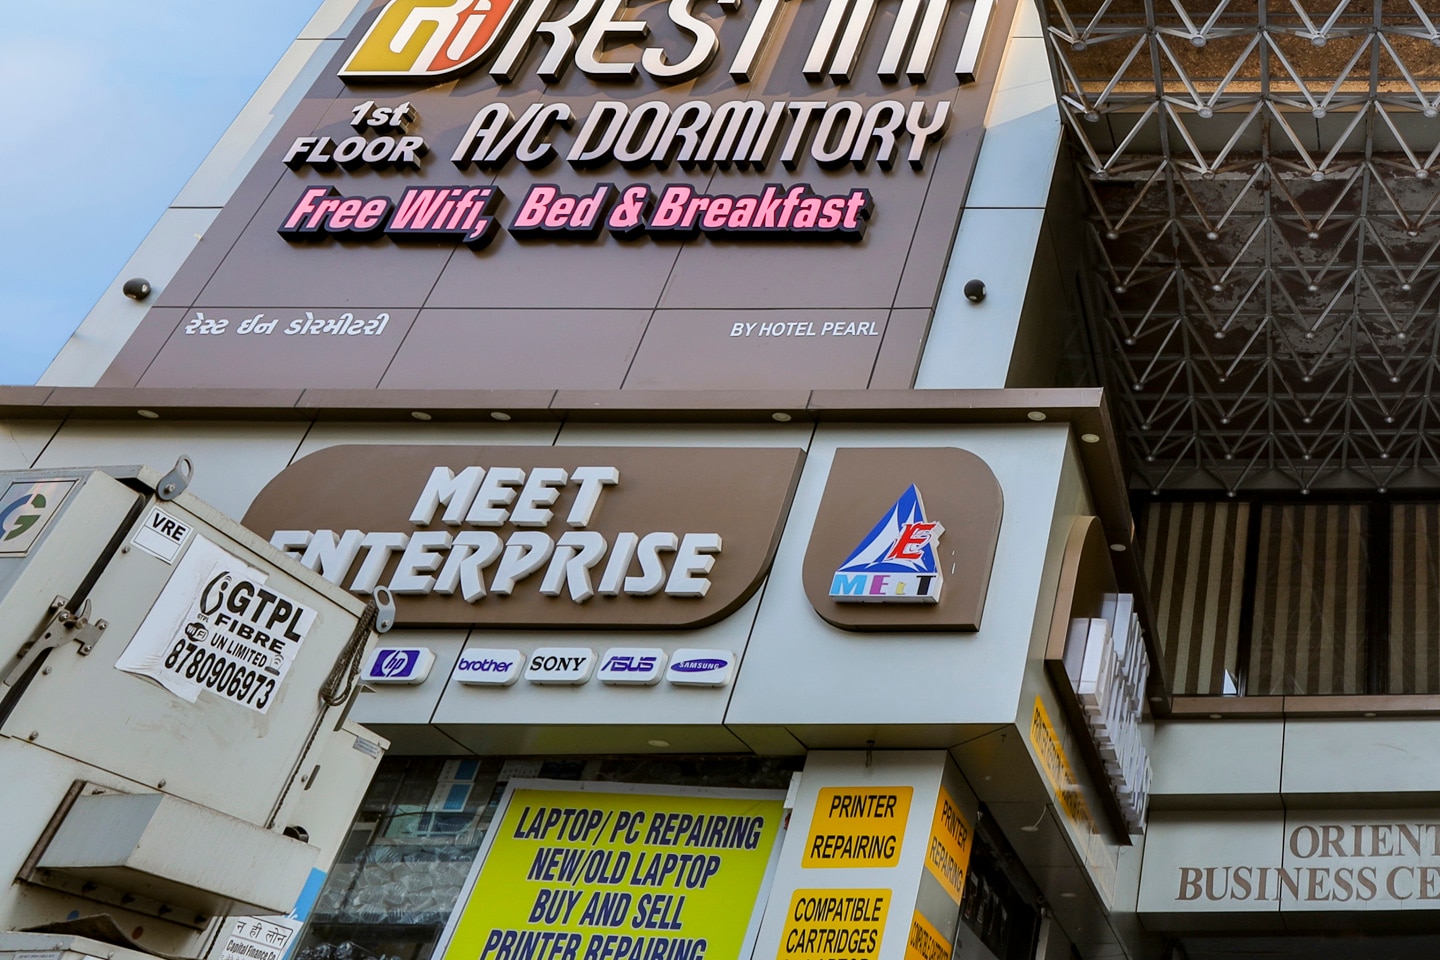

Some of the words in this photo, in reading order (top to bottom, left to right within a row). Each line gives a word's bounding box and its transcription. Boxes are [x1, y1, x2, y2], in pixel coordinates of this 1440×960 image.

[349, 101, 412, 130] 1st
[450, 102, 571, 168] A/C
[567, 101, 952, 171] DORMITORY
[283, 136, 425, 168] FLOOR
[284, 187, 388, 231] Free
[396, 187, 496, 239] Wifi,
[514, 185, 608, 229] Bed
[608, 185, 645, 229] &
[651, 185, 866, 230] Breakfast
[730, 322, 757, 337] BY
[758, 322, 816, 336] HOTEL
[821, 321, 879, 336] PEARL
[409, 466, 619, 528] MEET
[152, 512, 187, 542] VRE
[226, 581, 304, 643] GTPL
[214, 613, 286, 655] FIBRE
[164, 638, 276, 710] 8780906973
[458, 657, 513, 673] brother
[529, 656, 587, 672] SONY
[601, 656, 657, 672] ASUS
[679, 662, 721, 671] SAMSUNG
[828, 795, 898, 819] PRINTER
[513, 806, 613, 846] LAPTOP/
[609, 811, 645, 845] PC
[644, 813, 764, 850] REPAIRING
[940, 799, 969, 853] PRINTER
[810, 835, 897, 860] REPAIRING
[527, 847, 631, 887] NEW/OLD
[630, 852, 721, 889] LAPTOP
[929, 835, 964, 893] REPAIRING
[1174, 865, 1378, 903] BUSINESS
[528, 889, 583, 925] BUY
[579, 891, 633, 928] AND
[632, 893, 686, 930] SELL
[794, 897, 884, 923] COMPATIBLE
[265, 927, 287, 946] लोन
[480, 929, 582, 960] PRINTER
[584, 935, 707, 960] REPAIRING
[786, 928, 878, 954] CARTRIDGES
